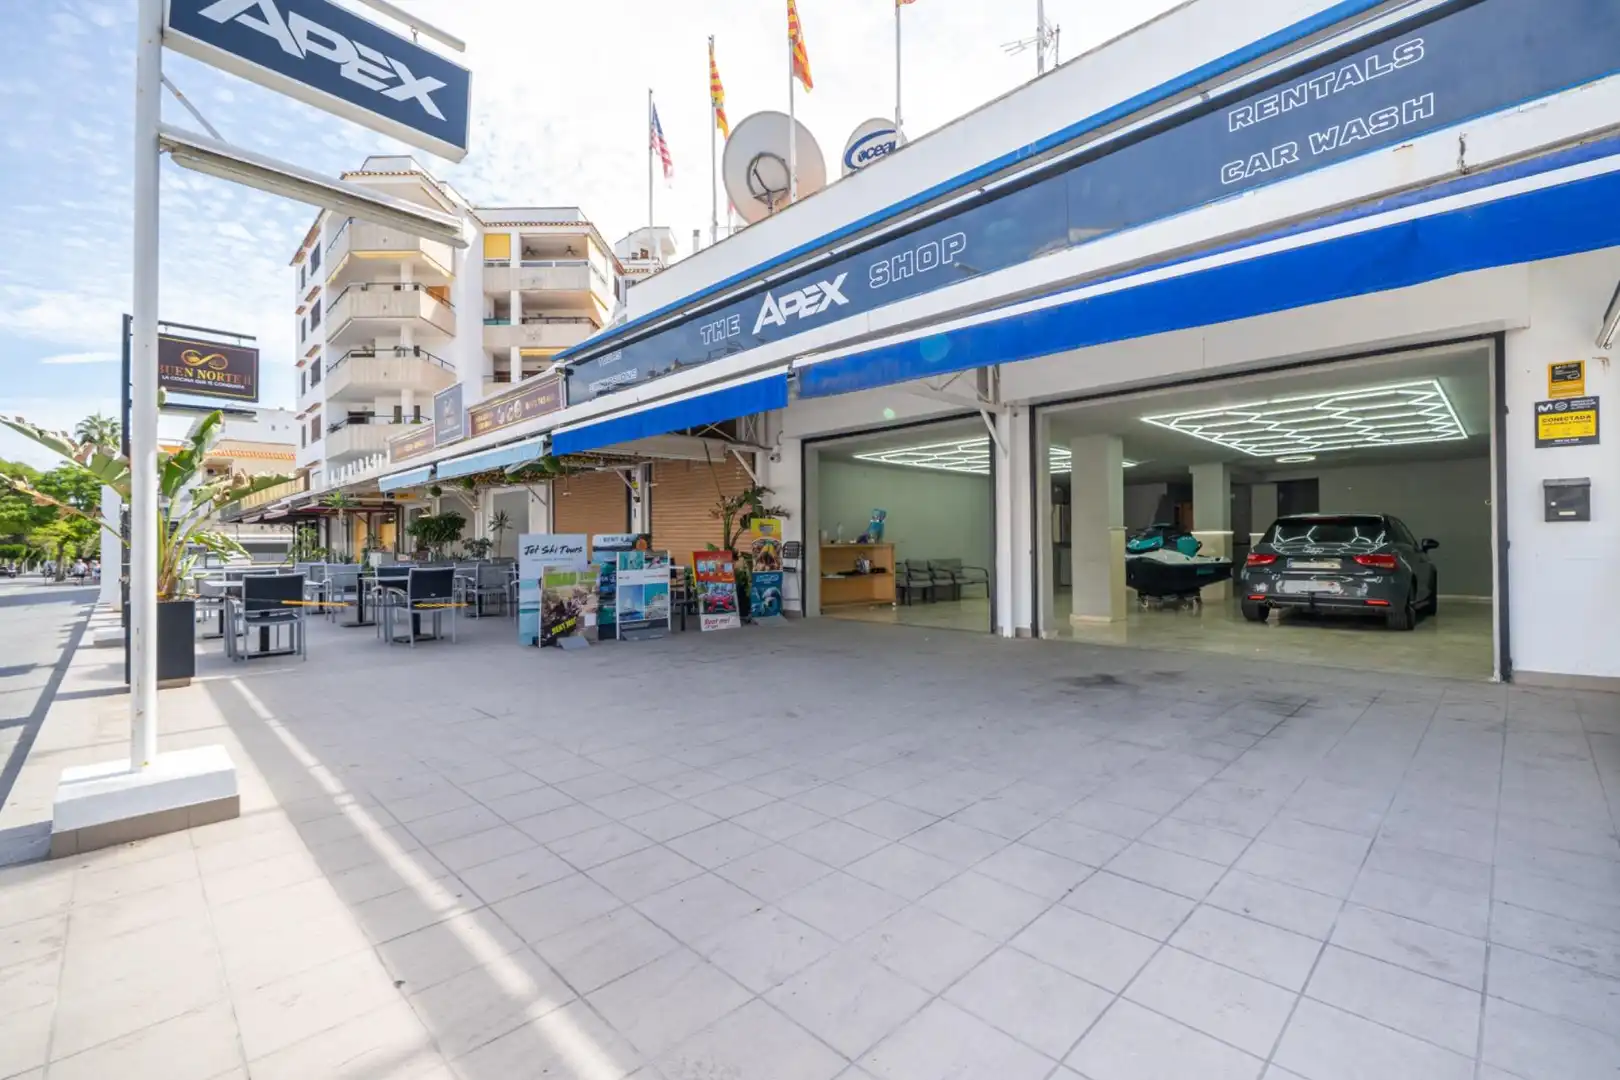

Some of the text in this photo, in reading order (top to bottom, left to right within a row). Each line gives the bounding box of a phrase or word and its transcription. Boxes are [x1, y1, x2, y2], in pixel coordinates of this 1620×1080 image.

[198, 0, 447, 121] APEX
[1228, 38, 1425, 132] RENTALS
[1221, 92, 1435, 184] CAR WASH
[700, 232, 967, 345] THE APEX SHOP
[197, 369, 242, 384] NORTE
[524, 544, 583, 556] Jet Ski Tours
